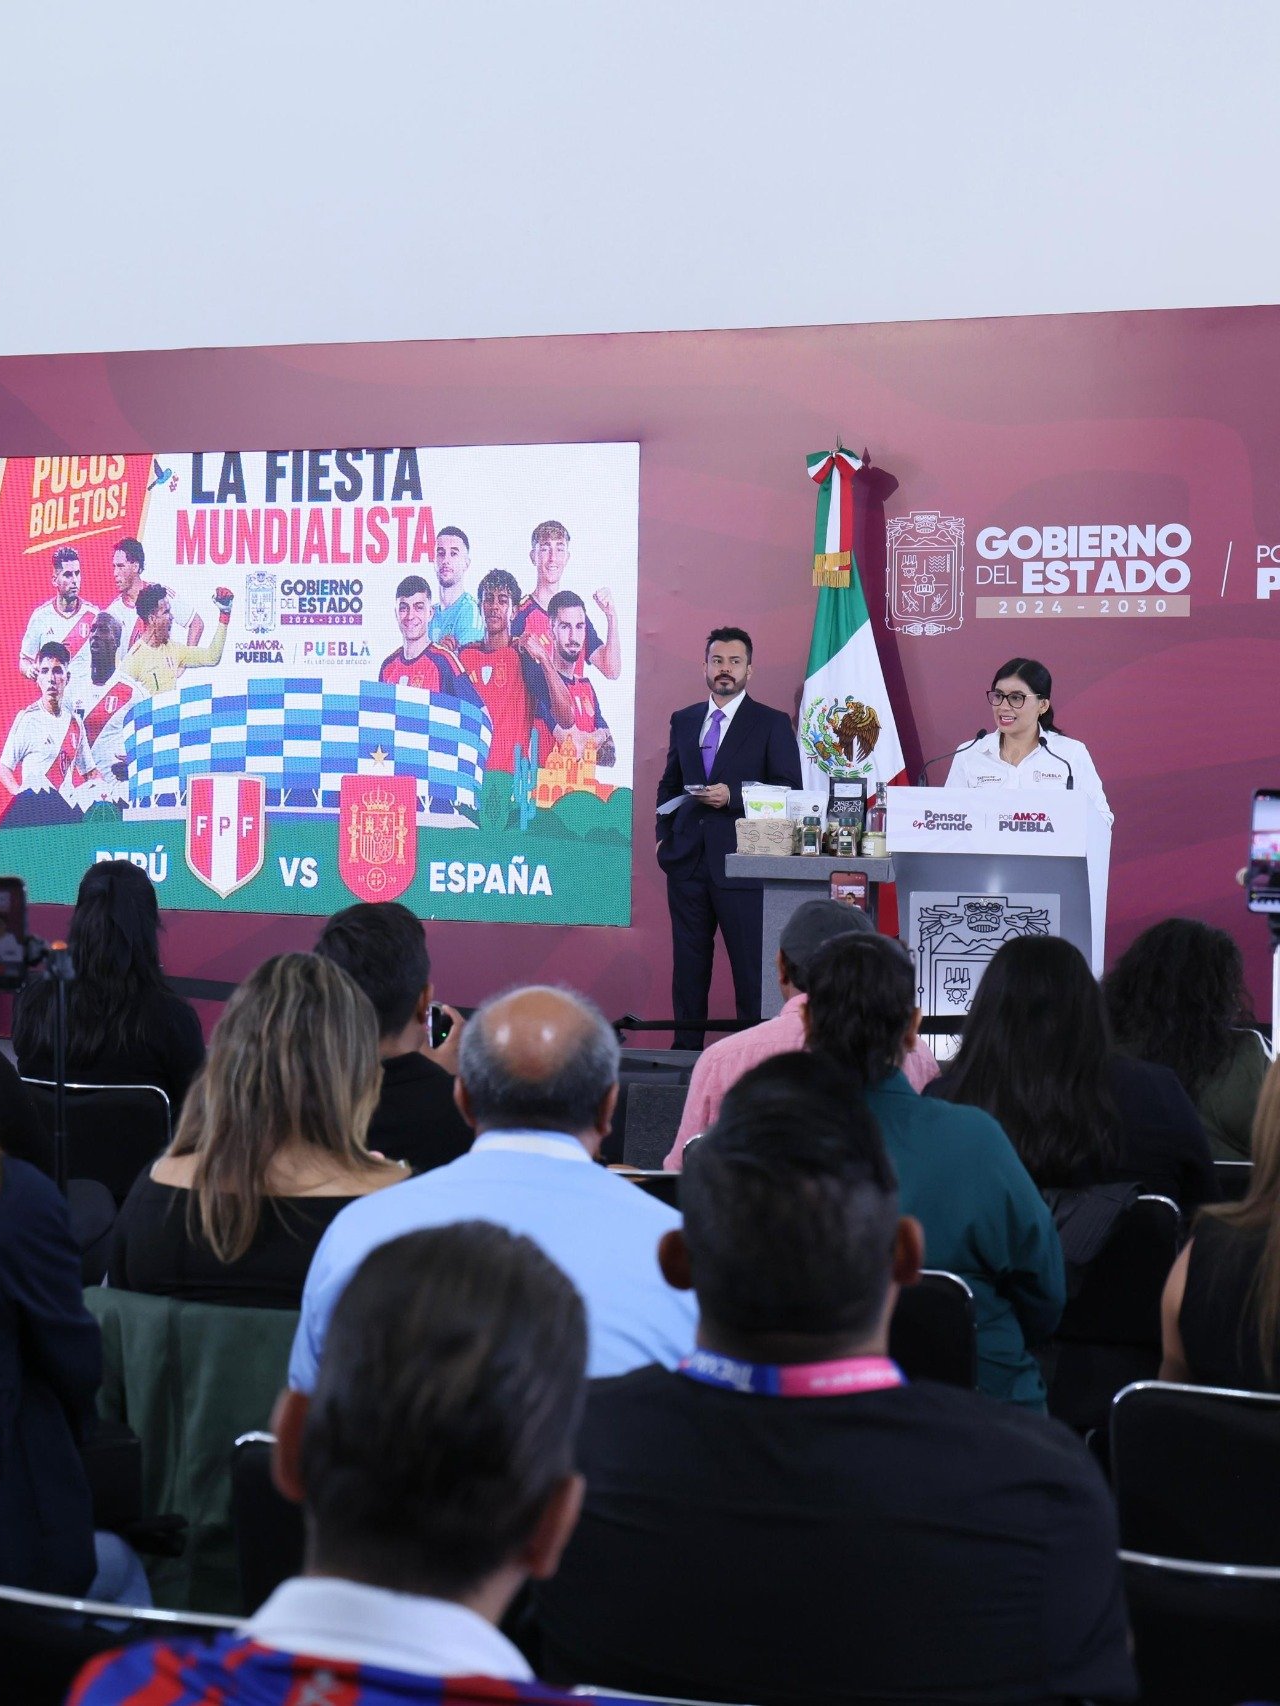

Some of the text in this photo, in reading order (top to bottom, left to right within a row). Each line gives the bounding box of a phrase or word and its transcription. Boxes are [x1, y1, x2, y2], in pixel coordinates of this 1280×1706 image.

[191, 447, 423, 504] LA FIESTA
[29, 482, 128, 538] BOLETOS!
[175, 506, 435, 565] MUNDIALISTA
[976, 523, 1192, 560] GOBIERNO
[976, 558, 1191, 594] DEL ESTADO
[280, 579, 363, 596] GOBIERNO
[298, 597, 363, 613] ESTADO
[998, 600, 1062, 614] 2024
[1100, 599, 1167, 614] 2030
[304, 641, 370, 656] PUEBLA
[235, 651, 284, 663] PUEBLA
[924, 810, 967, 822] Pensar
[1013, 812, 1046, 821] AMOR
[913, 819, 972, 831] en Grande
[998, 821, 1054, 832] PUEBLA
[278, 856, 319, 888] VS
[429, 855, 553, 896] ESPAÑA
